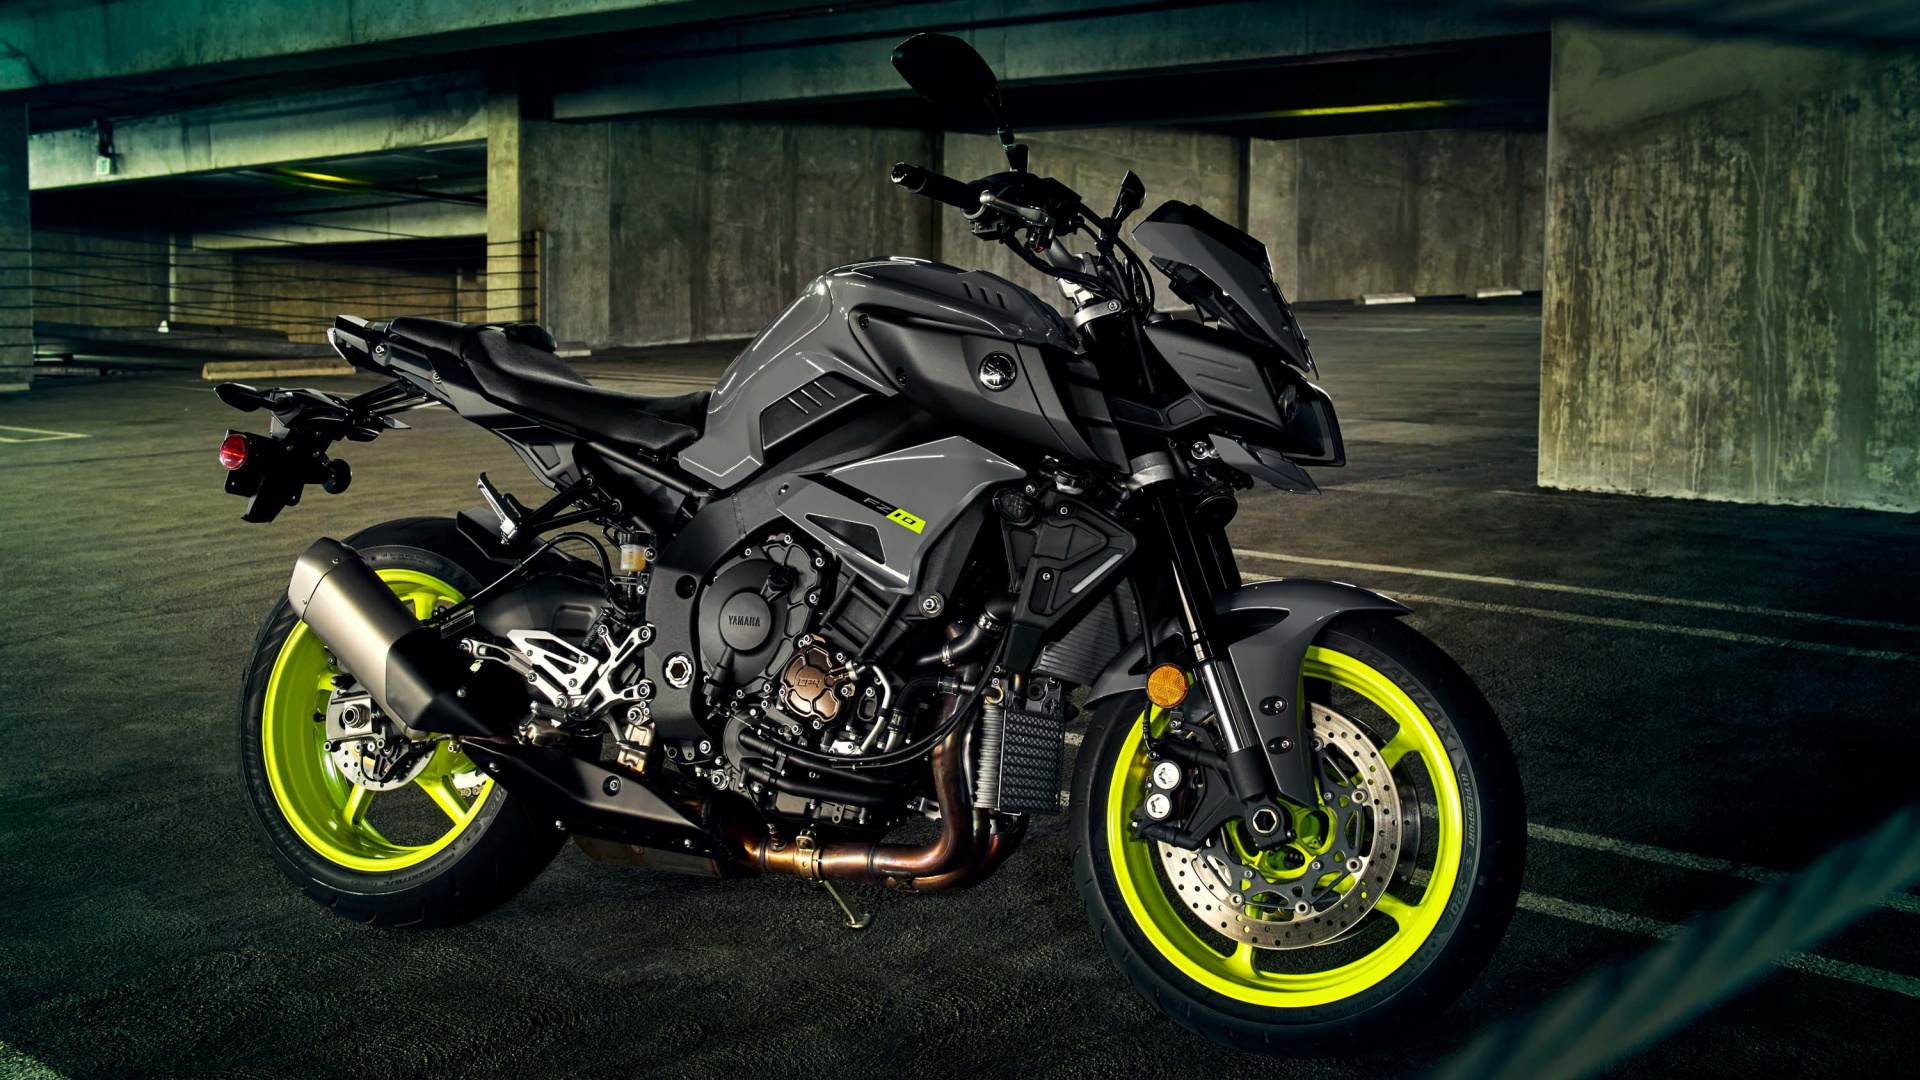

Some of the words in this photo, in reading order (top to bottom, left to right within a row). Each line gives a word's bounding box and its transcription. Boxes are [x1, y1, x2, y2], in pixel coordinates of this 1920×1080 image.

[728, 615, 761, 627] YAMAHA
[1363, 648, 1458, 744] BATTLAX
[1460, 773, 1476, 848] HYPERSPORT
